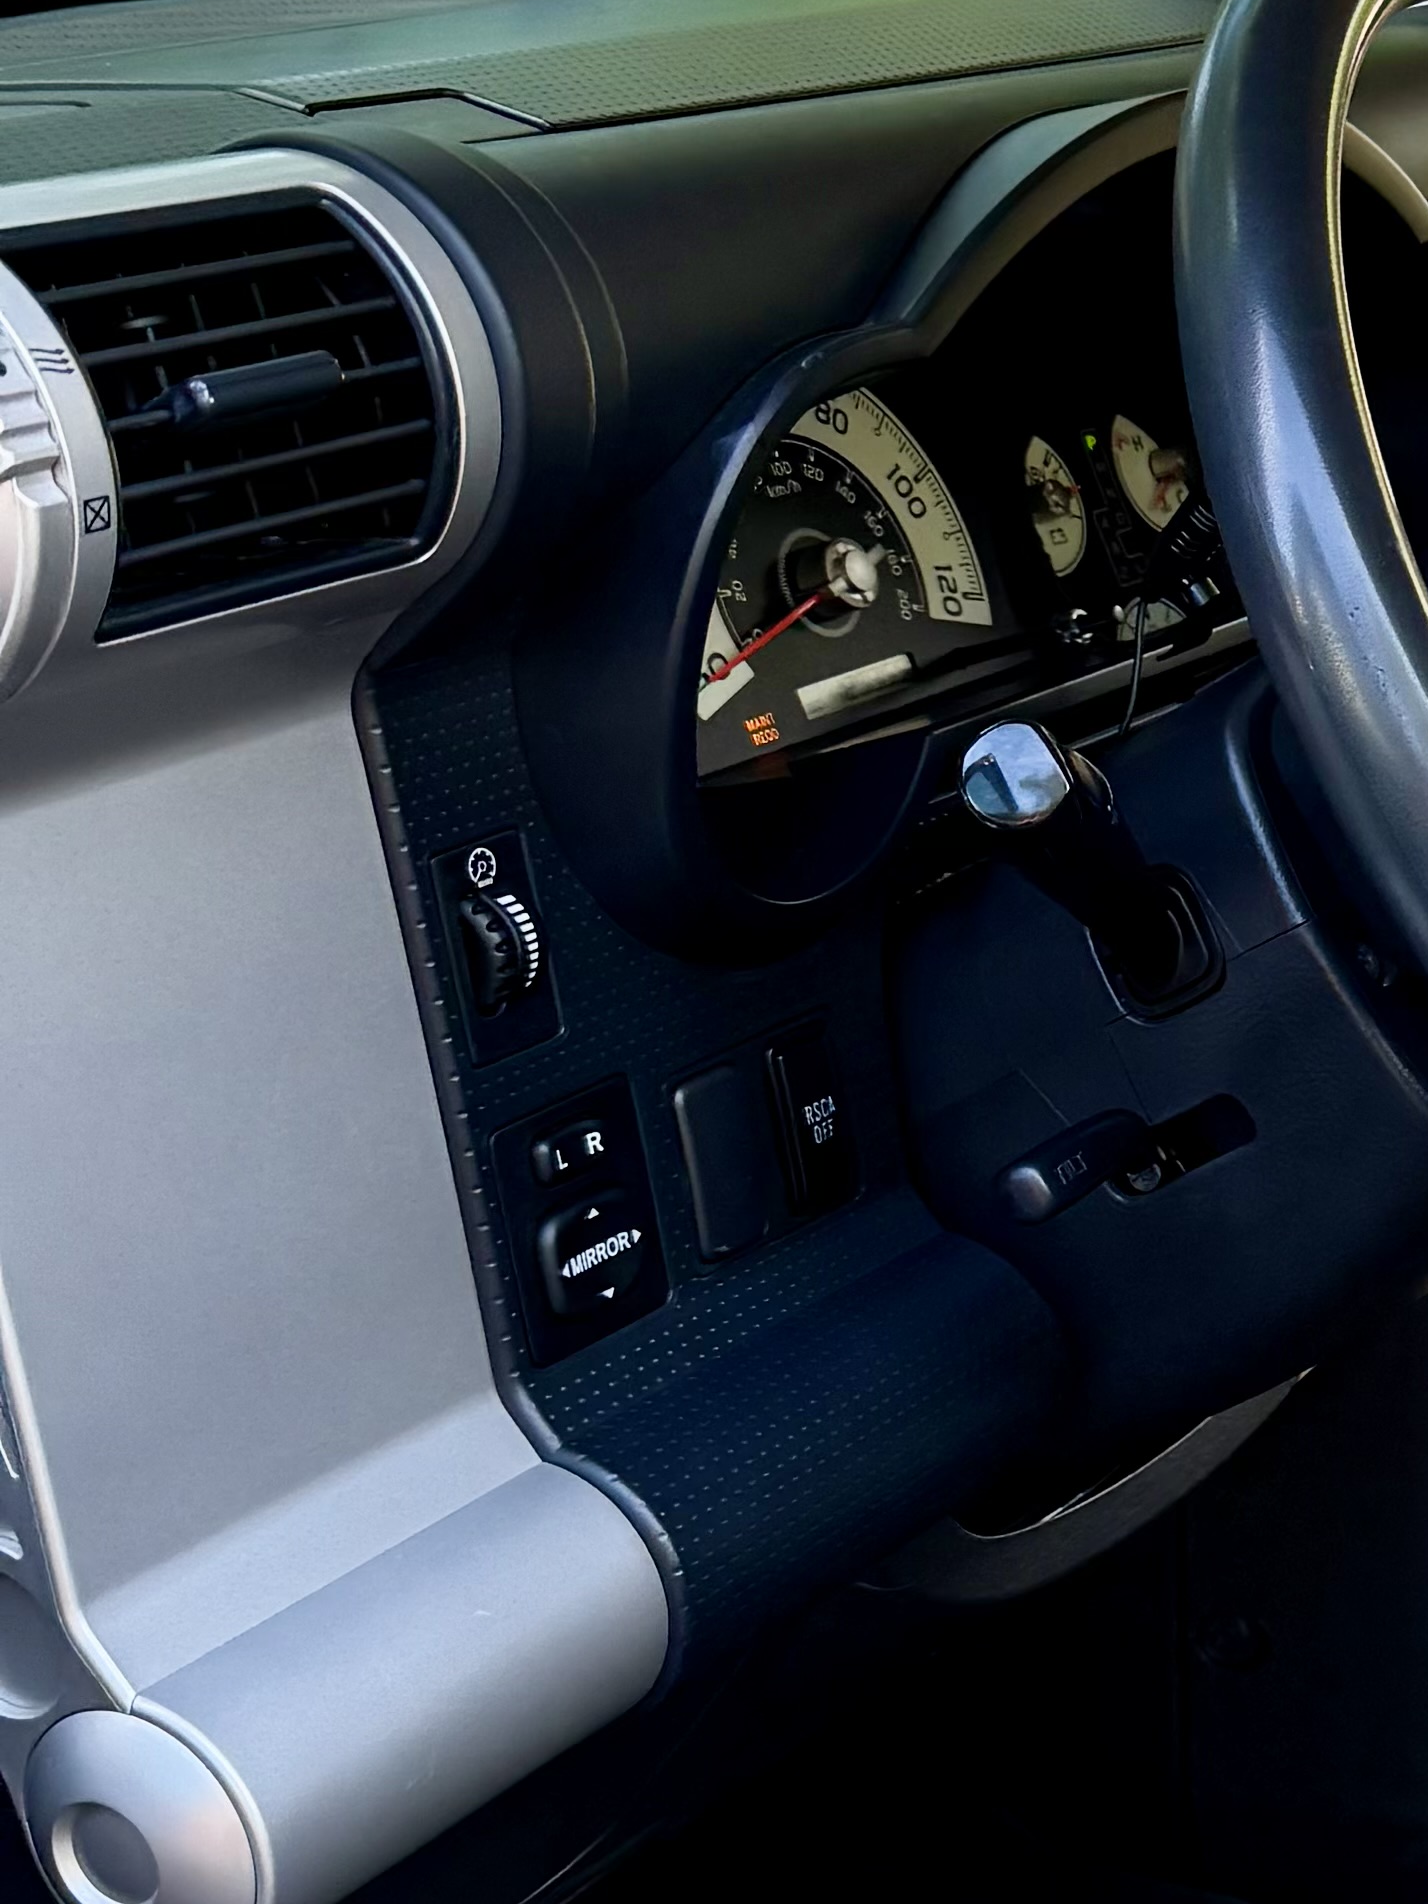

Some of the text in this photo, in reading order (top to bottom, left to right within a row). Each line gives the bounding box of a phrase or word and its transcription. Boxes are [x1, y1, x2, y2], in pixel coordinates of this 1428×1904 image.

[814, 401, 850, 436] 80
[769, 460, 793, 476] 100
[802, 463, 825, 482] 120
[885, 463, 927, 520] 100
[863, 510, 885, 537] 160
[933, 564, 963, 618] 120
[555, 1131, 604, 1170] L R
[570, 1231, 631, 1276] MIRROR
